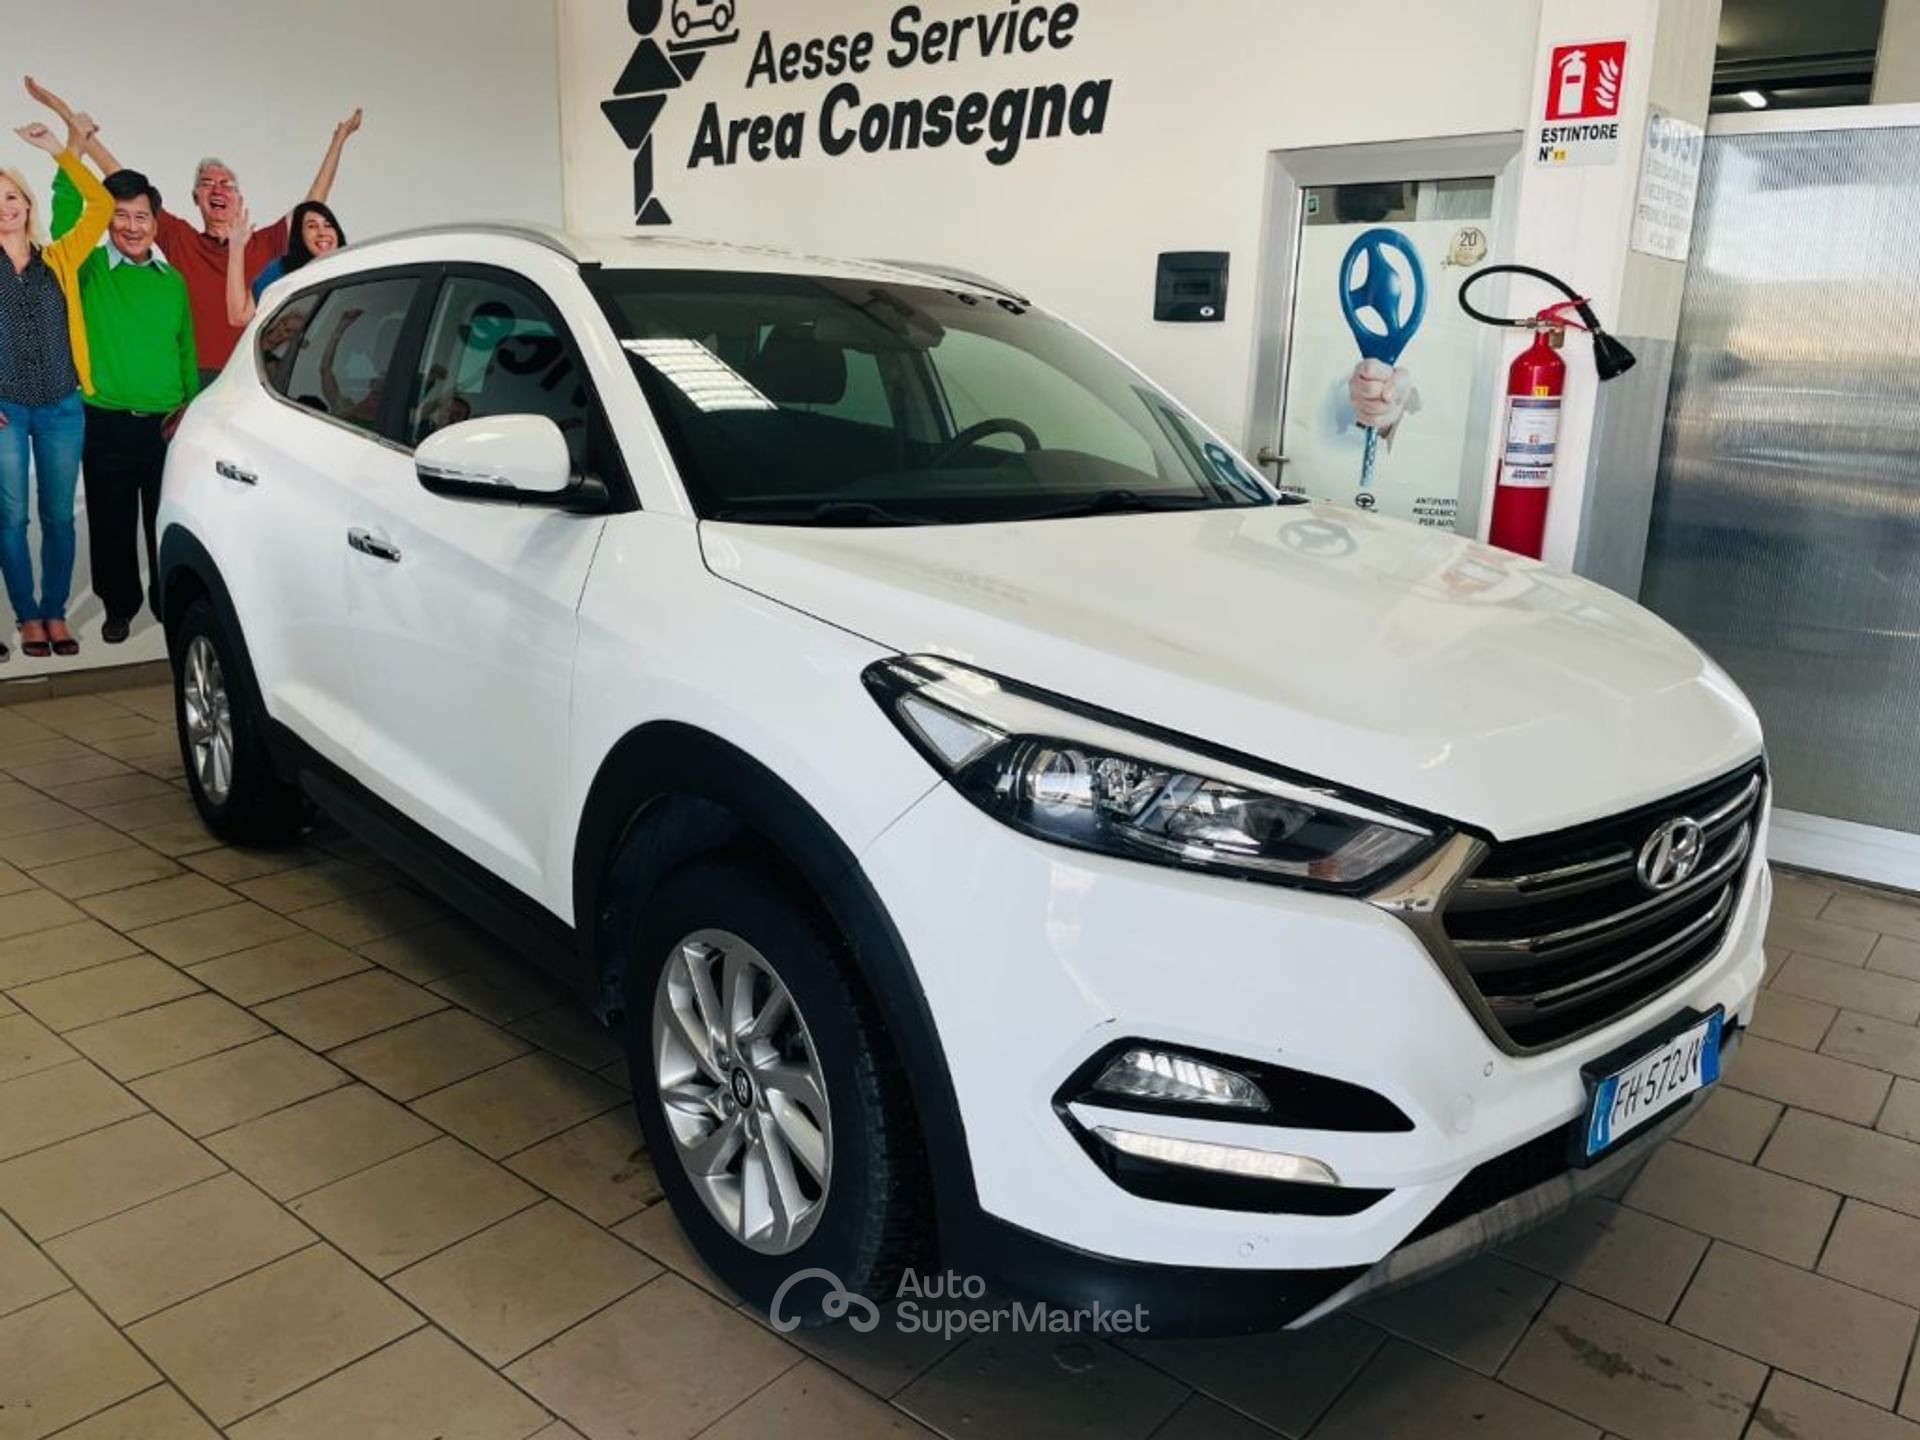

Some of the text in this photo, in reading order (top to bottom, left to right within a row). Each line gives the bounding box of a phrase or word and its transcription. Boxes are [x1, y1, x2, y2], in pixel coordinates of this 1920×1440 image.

[745, 0, 1079, 89] Aesse Service
[686, 78, 1113, 168] Area Consegna
[1541, 123, 1618, 143] ESTINTORE
[1460, 231, 1477, 247] 20
